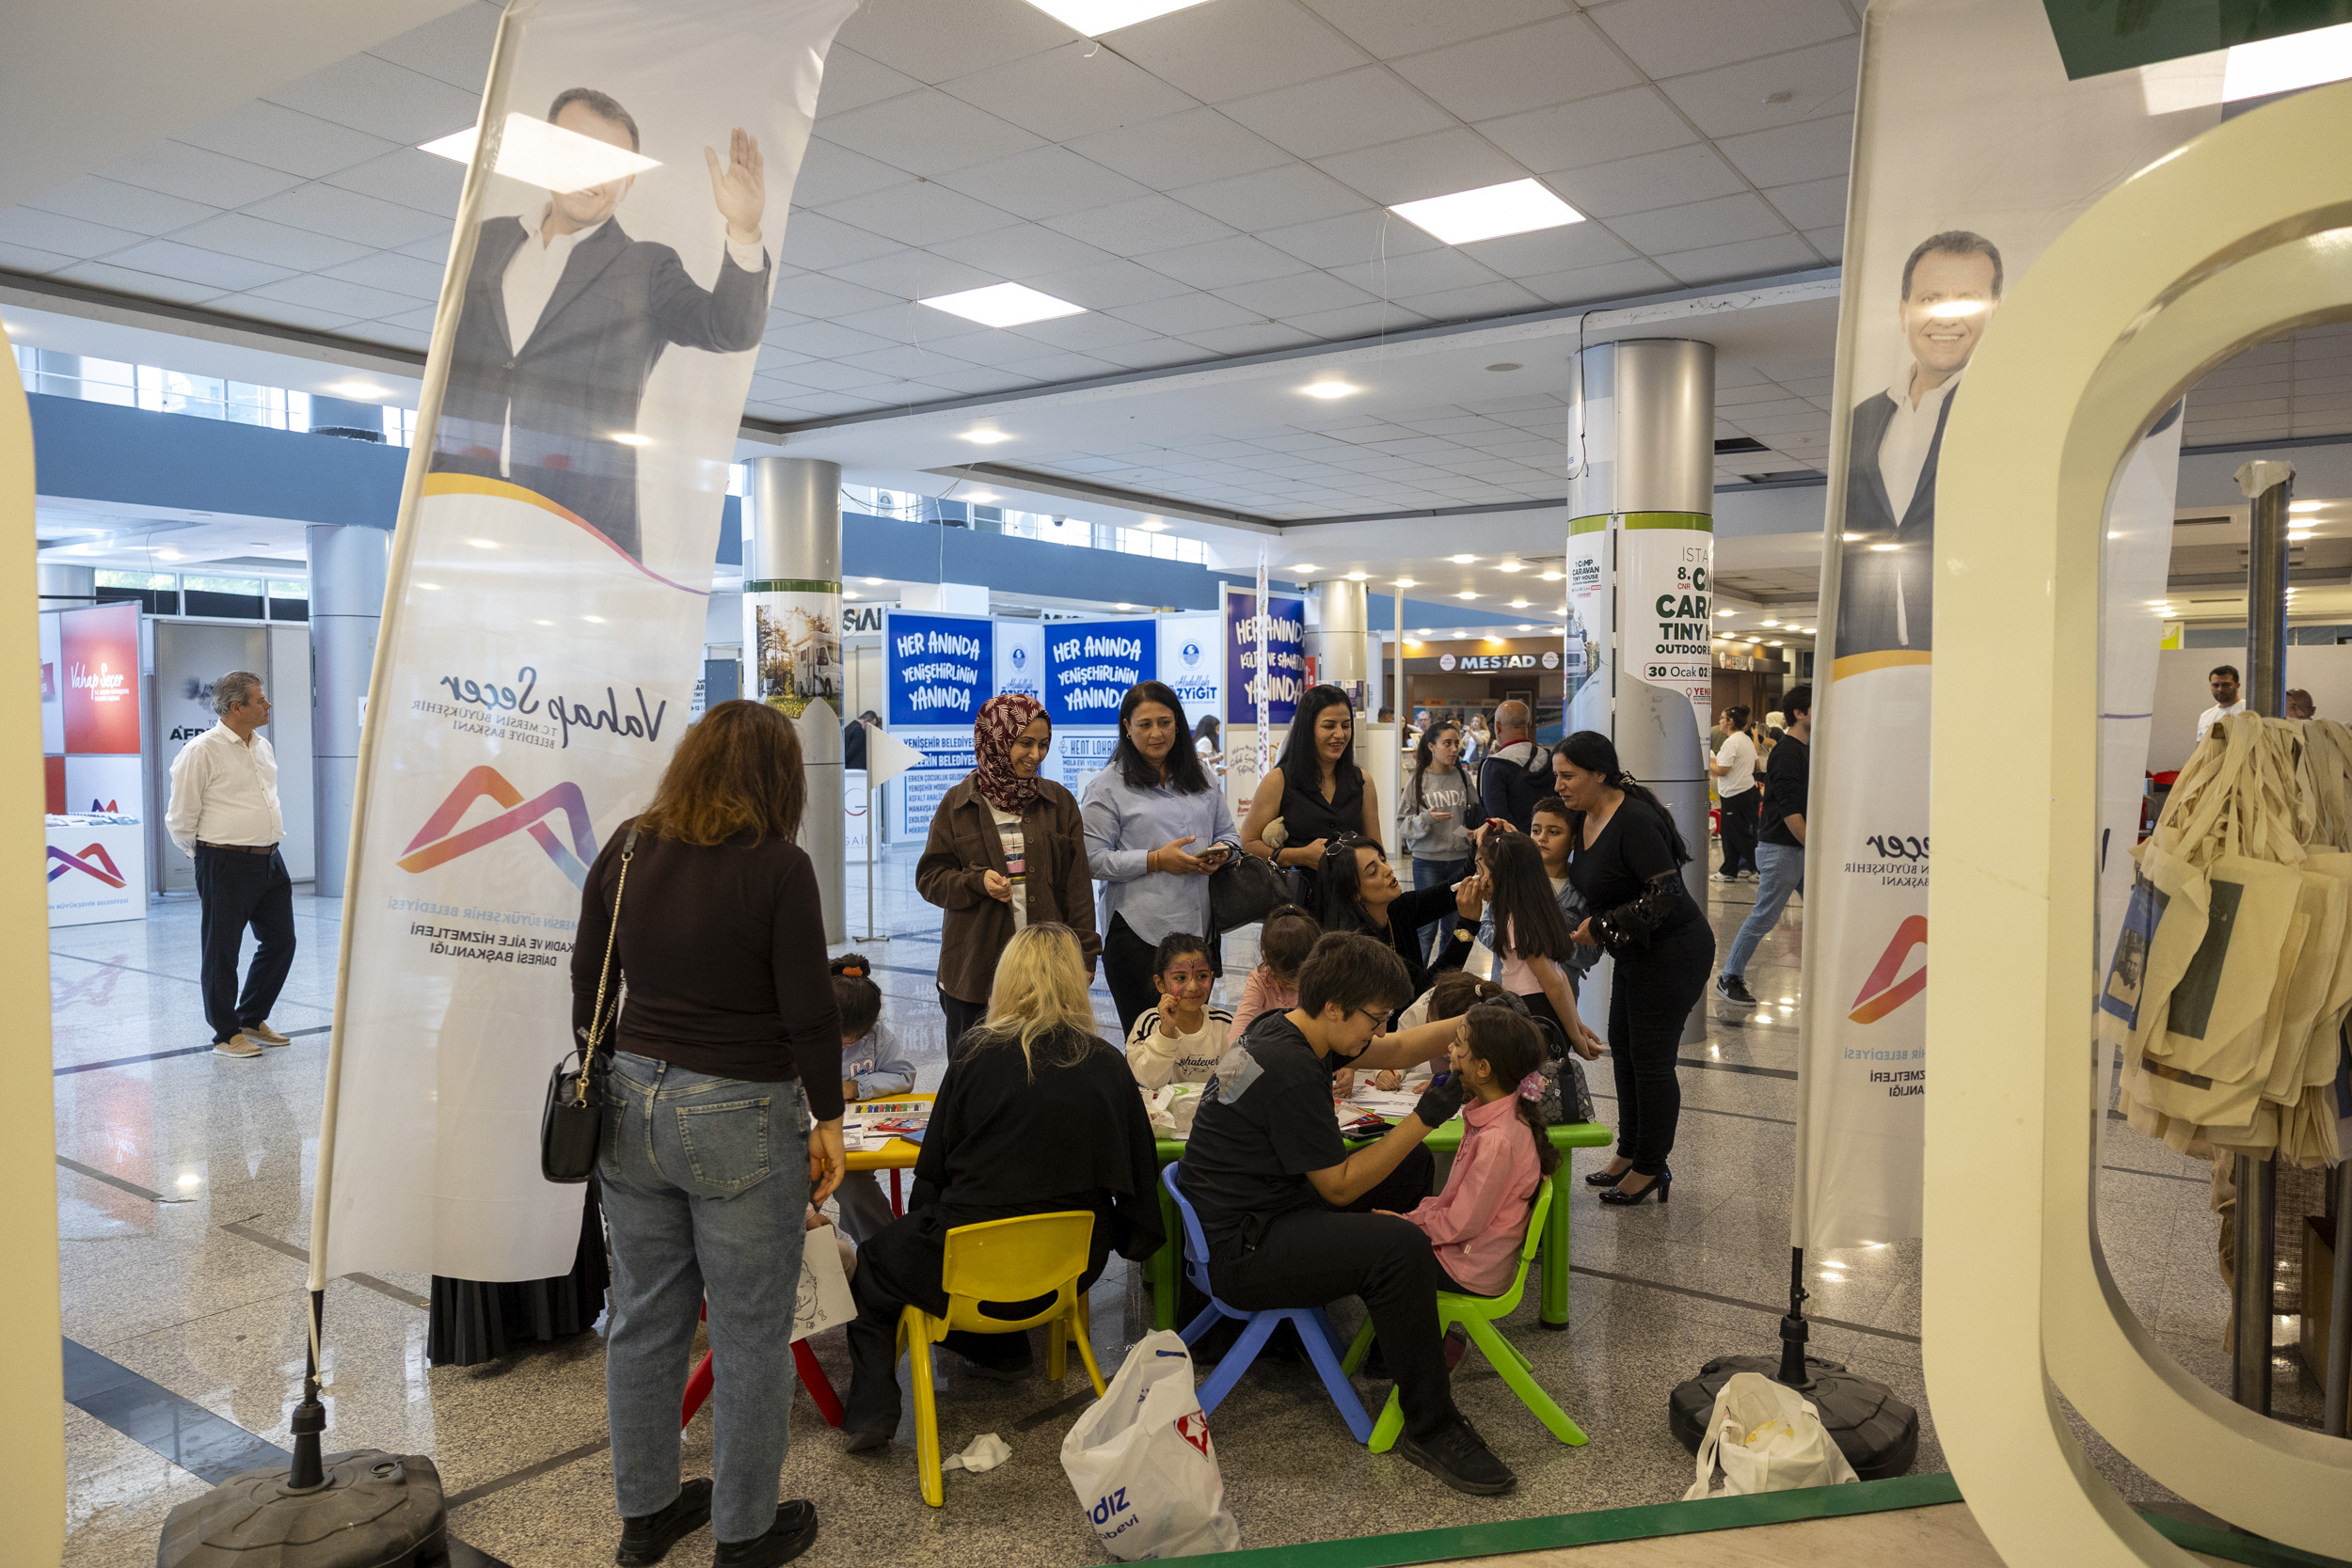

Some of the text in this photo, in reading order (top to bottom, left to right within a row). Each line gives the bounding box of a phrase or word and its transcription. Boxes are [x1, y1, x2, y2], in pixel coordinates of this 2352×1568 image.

[1573, 566, 1600, 576] CARAVAN
[1659, 623, 1703, 641] TINY
[897, 631, 980, 661] HER ANINDA
[1053, 636, 1141, 664] HER ANINDA
[1655, 644, 1707, 656] OUTDOOR
[902, 663, 978, 685] YENİŞEHİRLİNİN
[1057, 665, 1139, 686] YENİŞEHİRLİNİN
[1648, 665, 1708, 678] 30 Ocak 02
[71, 662, 98, 701] Vahap
[1175, 675, 1210, 688] Abdullah
[908, 685, 970, 712] YANINDA
[904, 736, 940, 751] YENİŞEHİR
[1071, 740, 1089, 755] KENT
[1180, 1056, 1220, 1067] whatever
